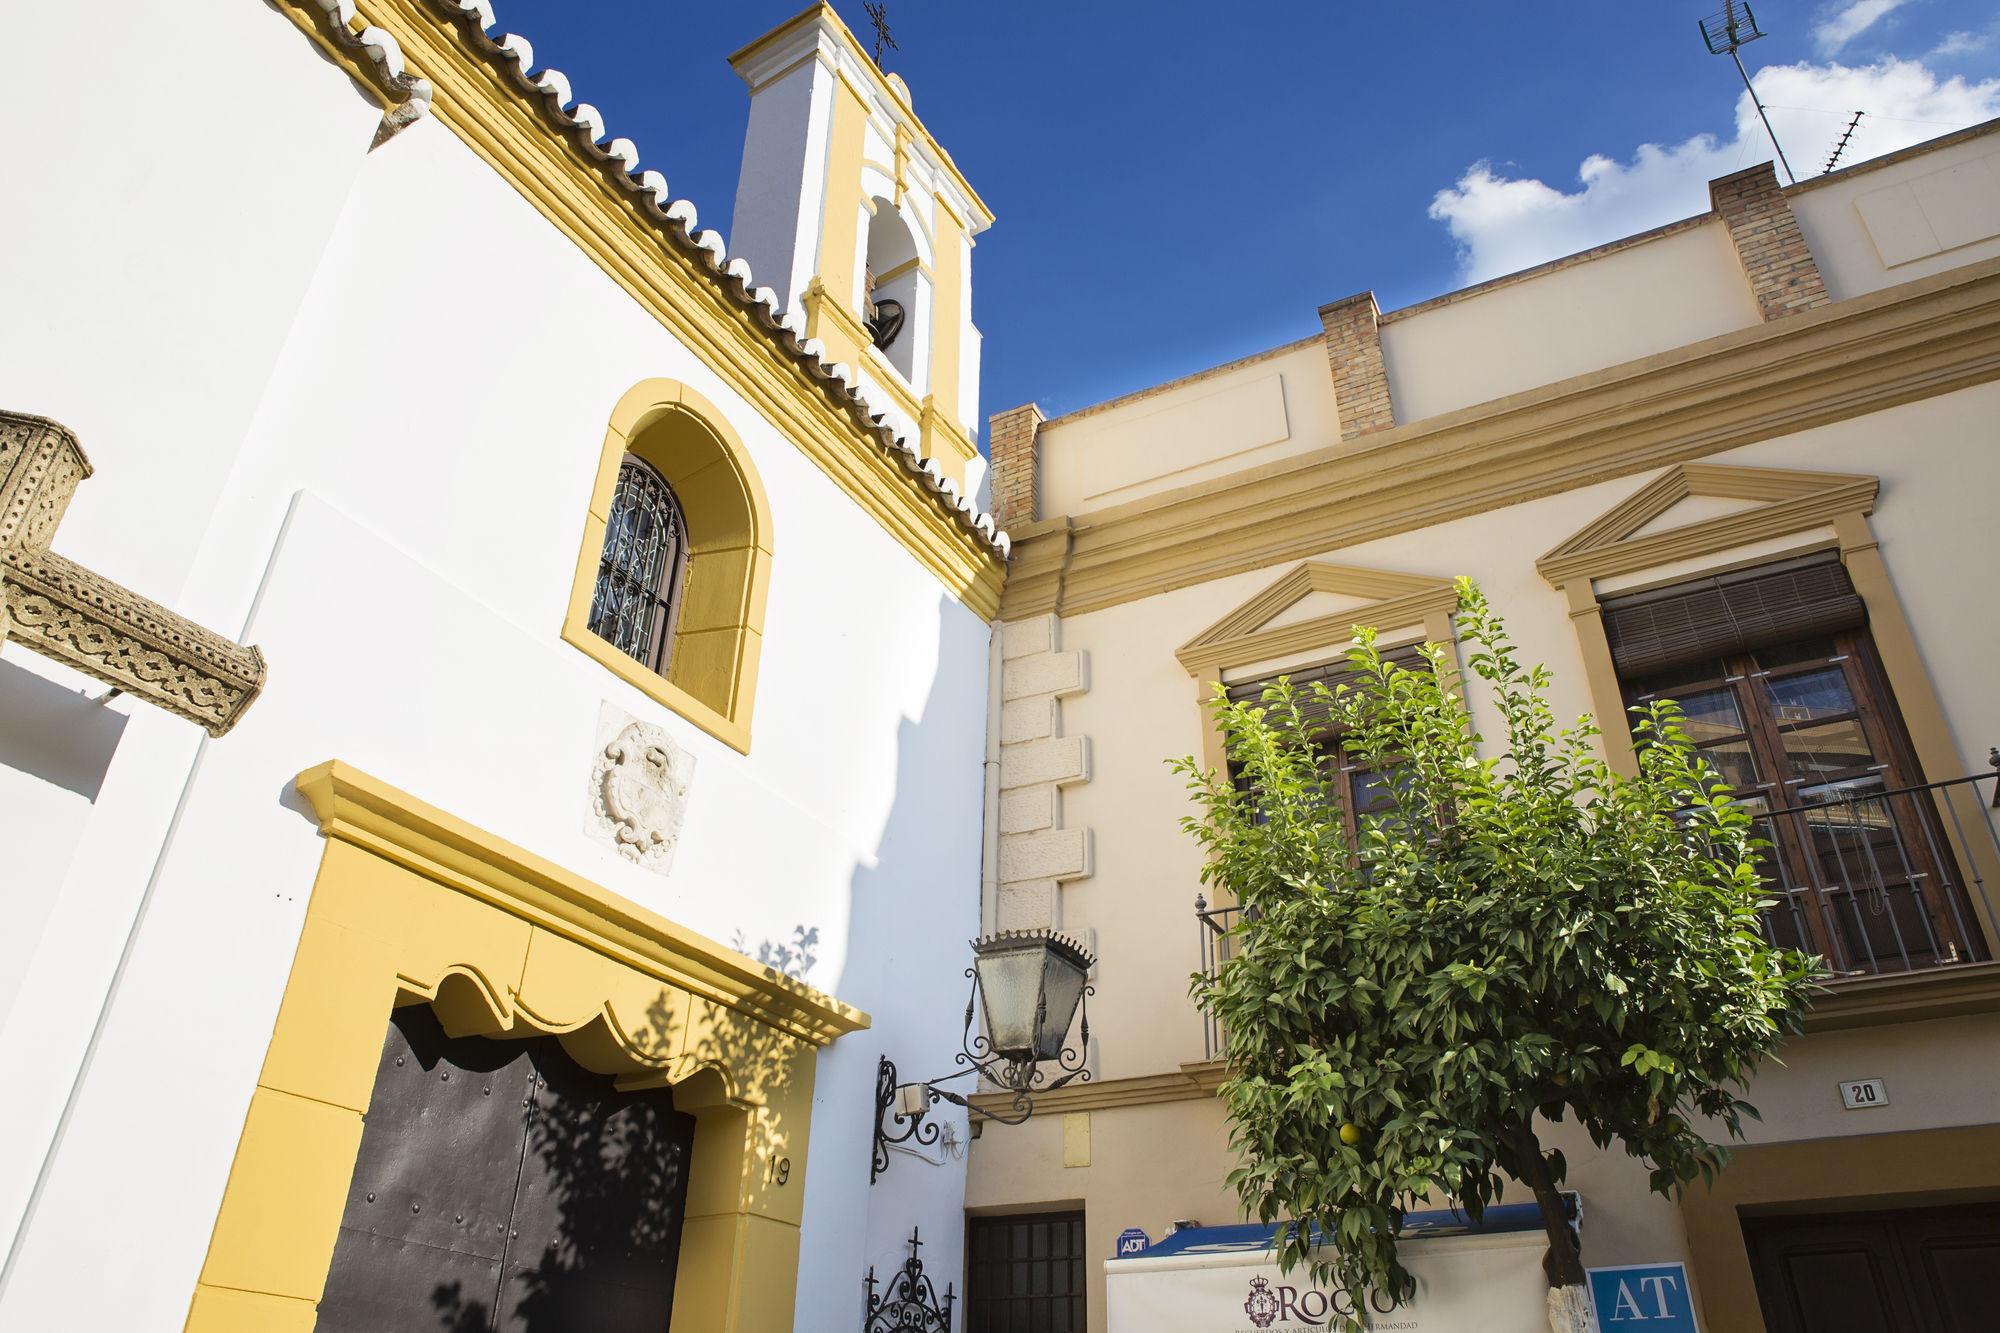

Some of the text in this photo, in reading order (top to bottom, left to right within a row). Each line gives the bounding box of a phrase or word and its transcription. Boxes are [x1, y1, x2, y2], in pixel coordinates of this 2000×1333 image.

[1851, 1083, 1876, 1103] 20
[769, 1154, 791, 1186] 19
[1121, 1239, 1146, 1253] ADT
[1275, 1286, 1398, 1326] ROCO
[1609, 1275, 1677, 1321] AT
